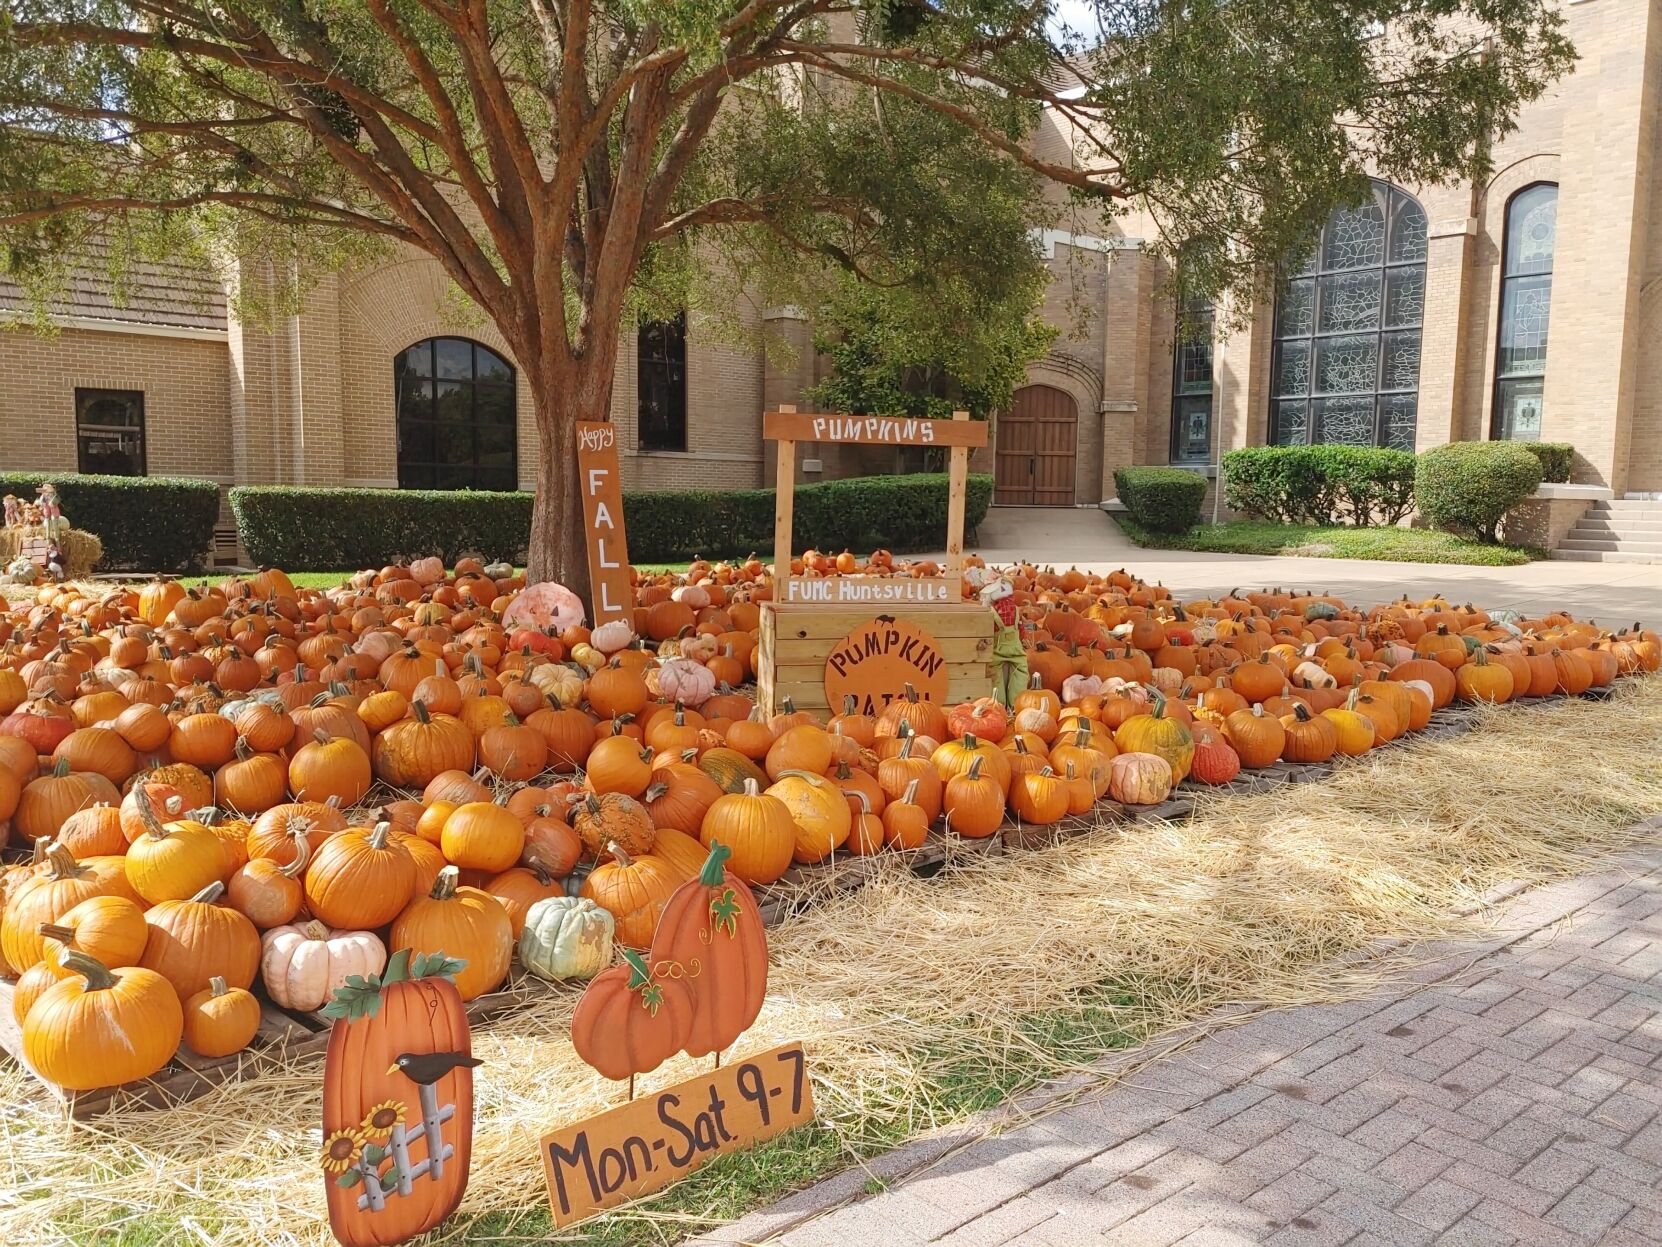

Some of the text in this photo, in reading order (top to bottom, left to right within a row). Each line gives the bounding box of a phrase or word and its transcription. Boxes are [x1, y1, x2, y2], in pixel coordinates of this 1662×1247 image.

[578, 425, 615, 452] Happy
[812, 417, 934, 443] PUMPKINS
[588, 469, 622, 612] FALL
[788, 580, 948, 601] FUMC Huntsville
[829, 629, 944, 679] PUMPKIN
[736, 1049, 804, 1126] 9-7
